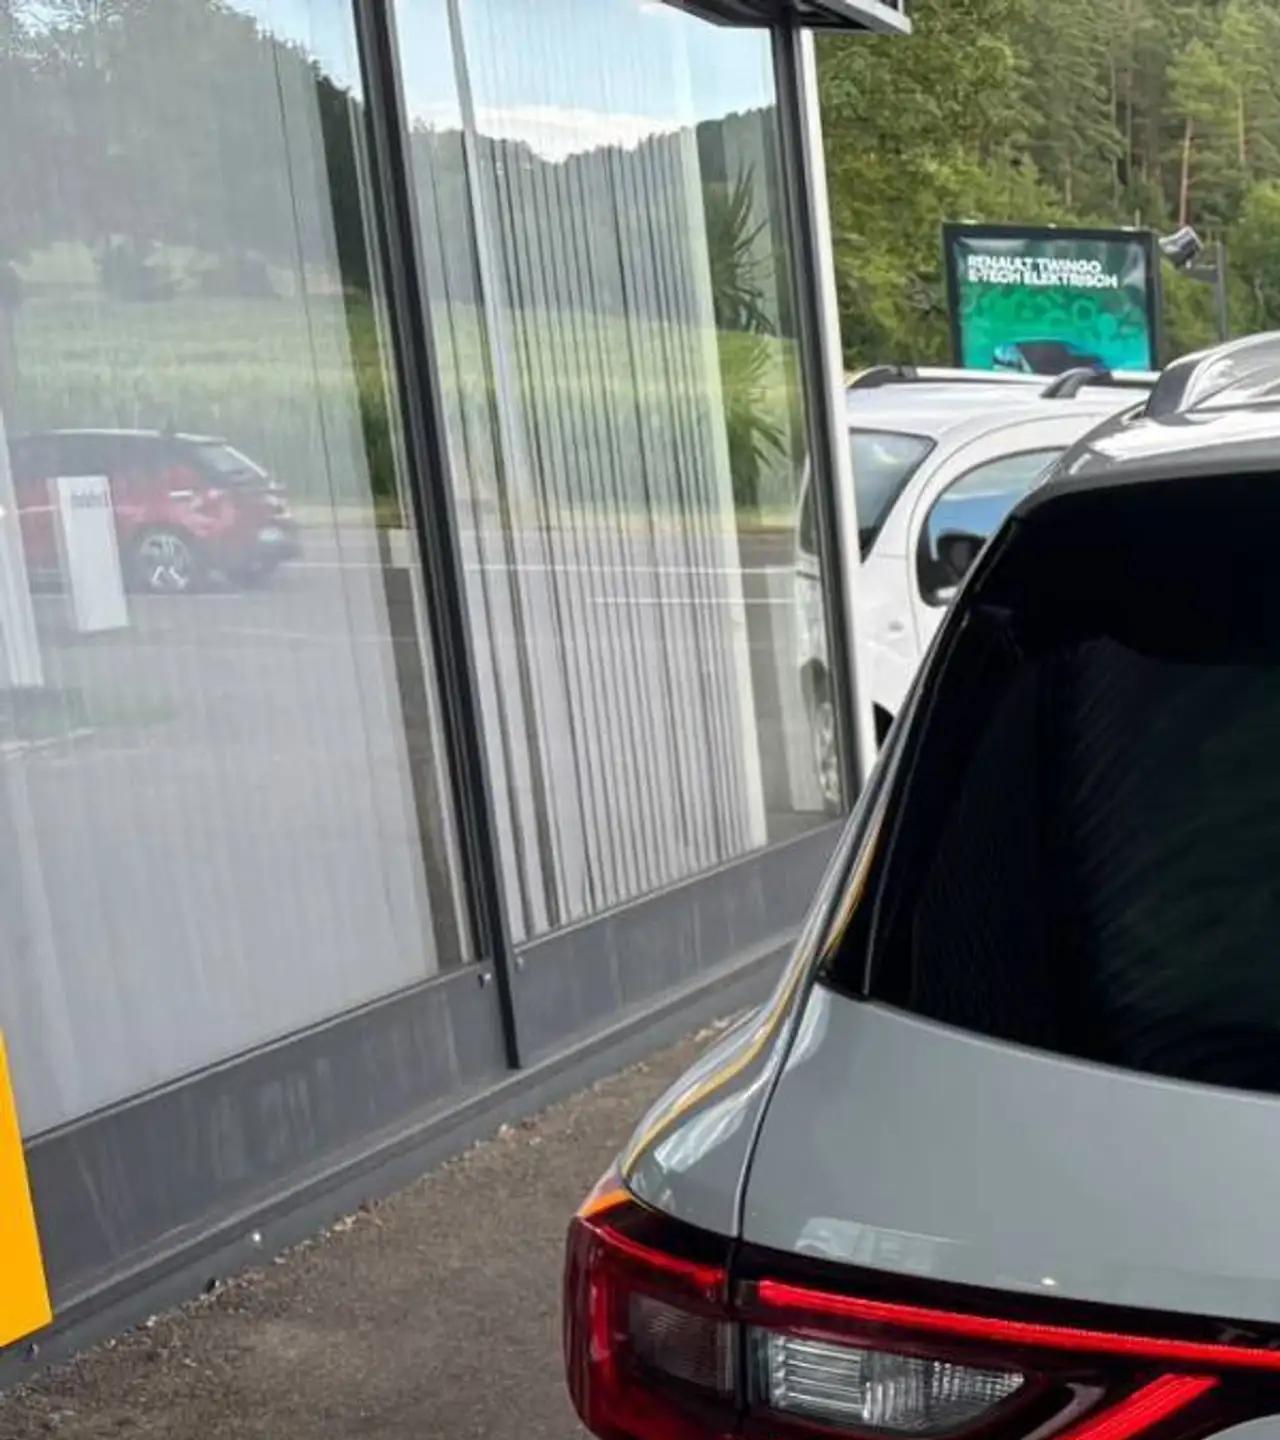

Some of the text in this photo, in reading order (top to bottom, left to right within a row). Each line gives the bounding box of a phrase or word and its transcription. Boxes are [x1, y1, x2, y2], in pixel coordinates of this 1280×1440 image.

[967, 254, 1102, 273] RENAULT TWINGO
[1024, 271, 1118, 289] ELEKTRISCH
